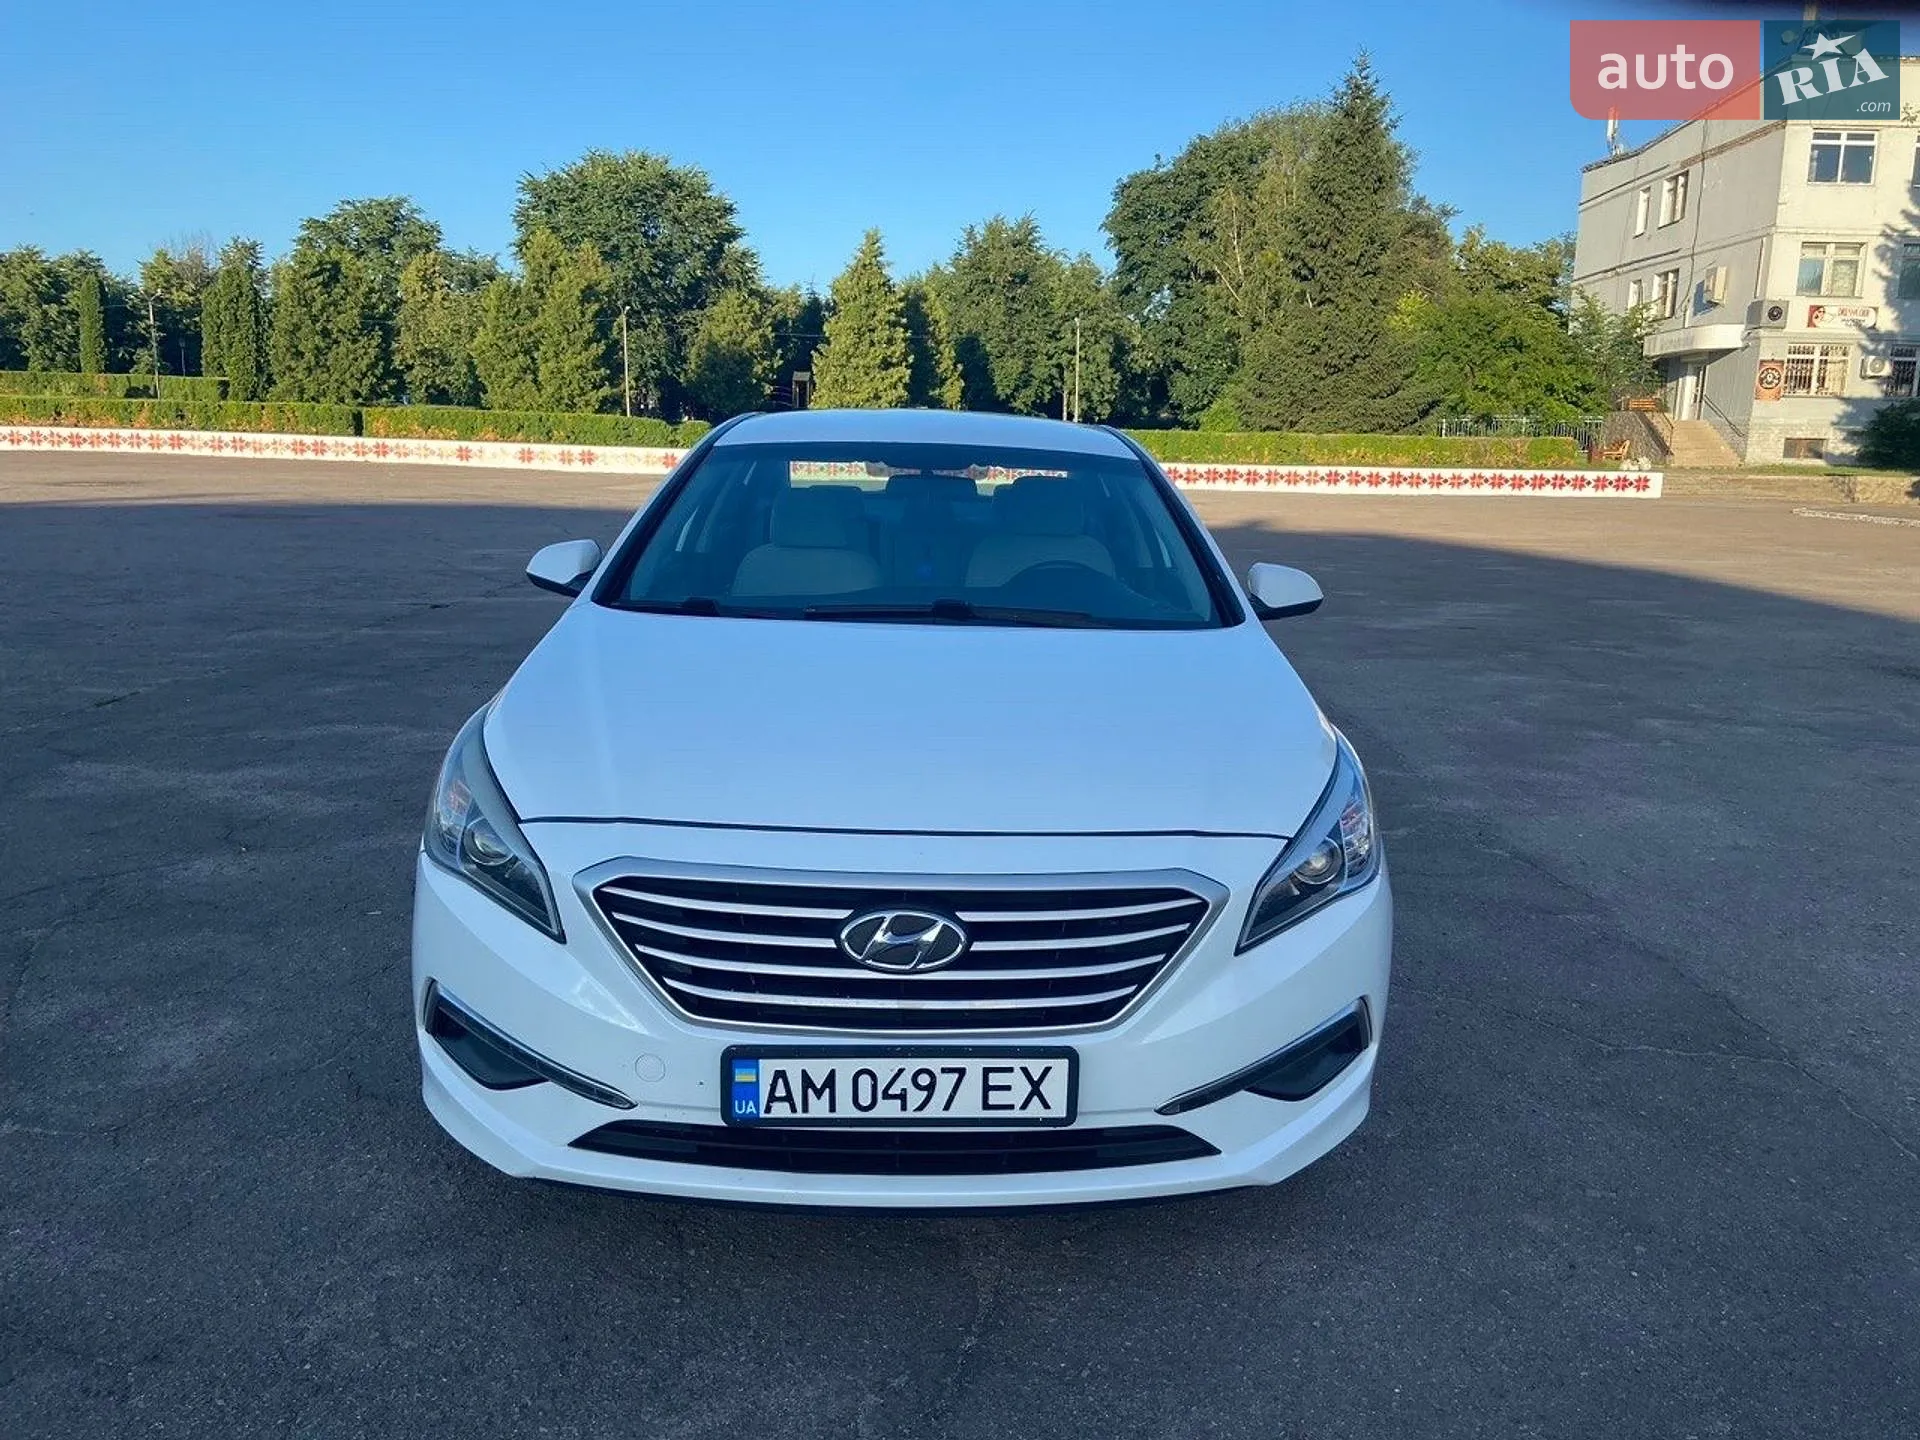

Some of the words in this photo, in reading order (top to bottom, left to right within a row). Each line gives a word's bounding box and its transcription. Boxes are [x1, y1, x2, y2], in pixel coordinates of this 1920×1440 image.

[764, 1068, 836, 1115] AM
[851, 1067, 967, 1113] 0497
[982, 1066, 1053, 1111] EX
[735, 1100, 757, 1115] UA
